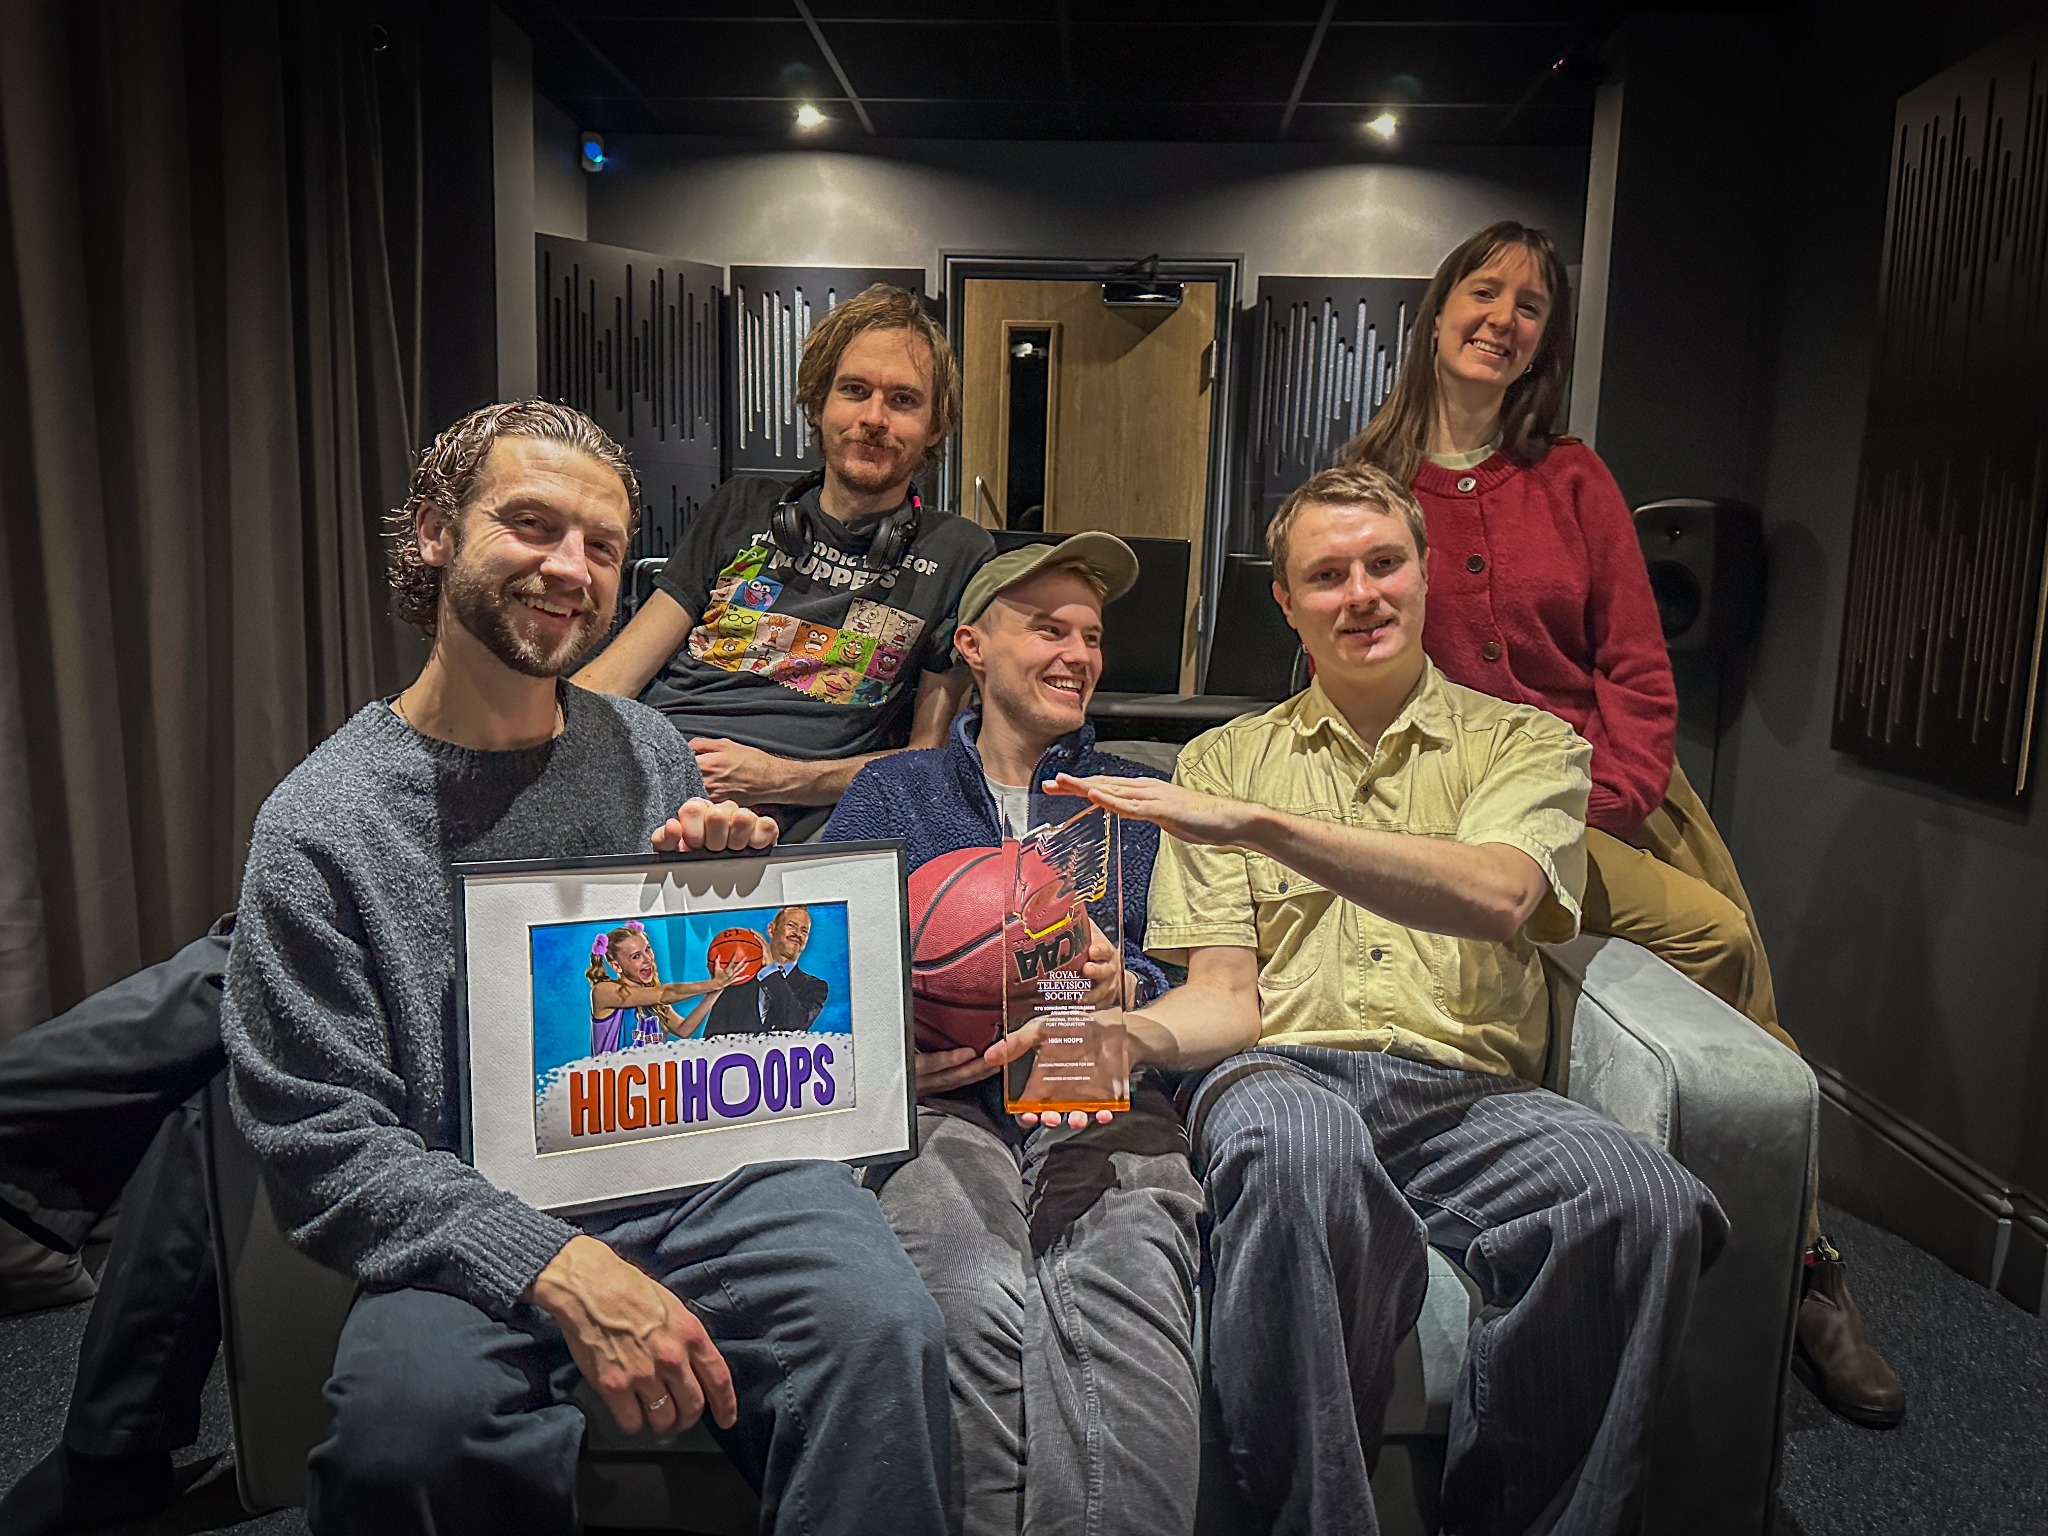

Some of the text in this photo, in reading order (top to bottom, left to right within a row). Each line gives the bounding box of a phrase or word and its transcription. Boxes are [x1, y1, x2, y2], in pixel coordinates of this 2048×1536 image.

[767, 549, 900, 590] MUPPETS
[913, 558, 939, 576] OF
[1049, 970, 1080, 979] ROYAL
[1037, 981, 1092, 990] TELEVISION
[1044, 991, 1085, 1001] SOCIETY
[569, 1043, 836, 1137] HIGH HOOPS
